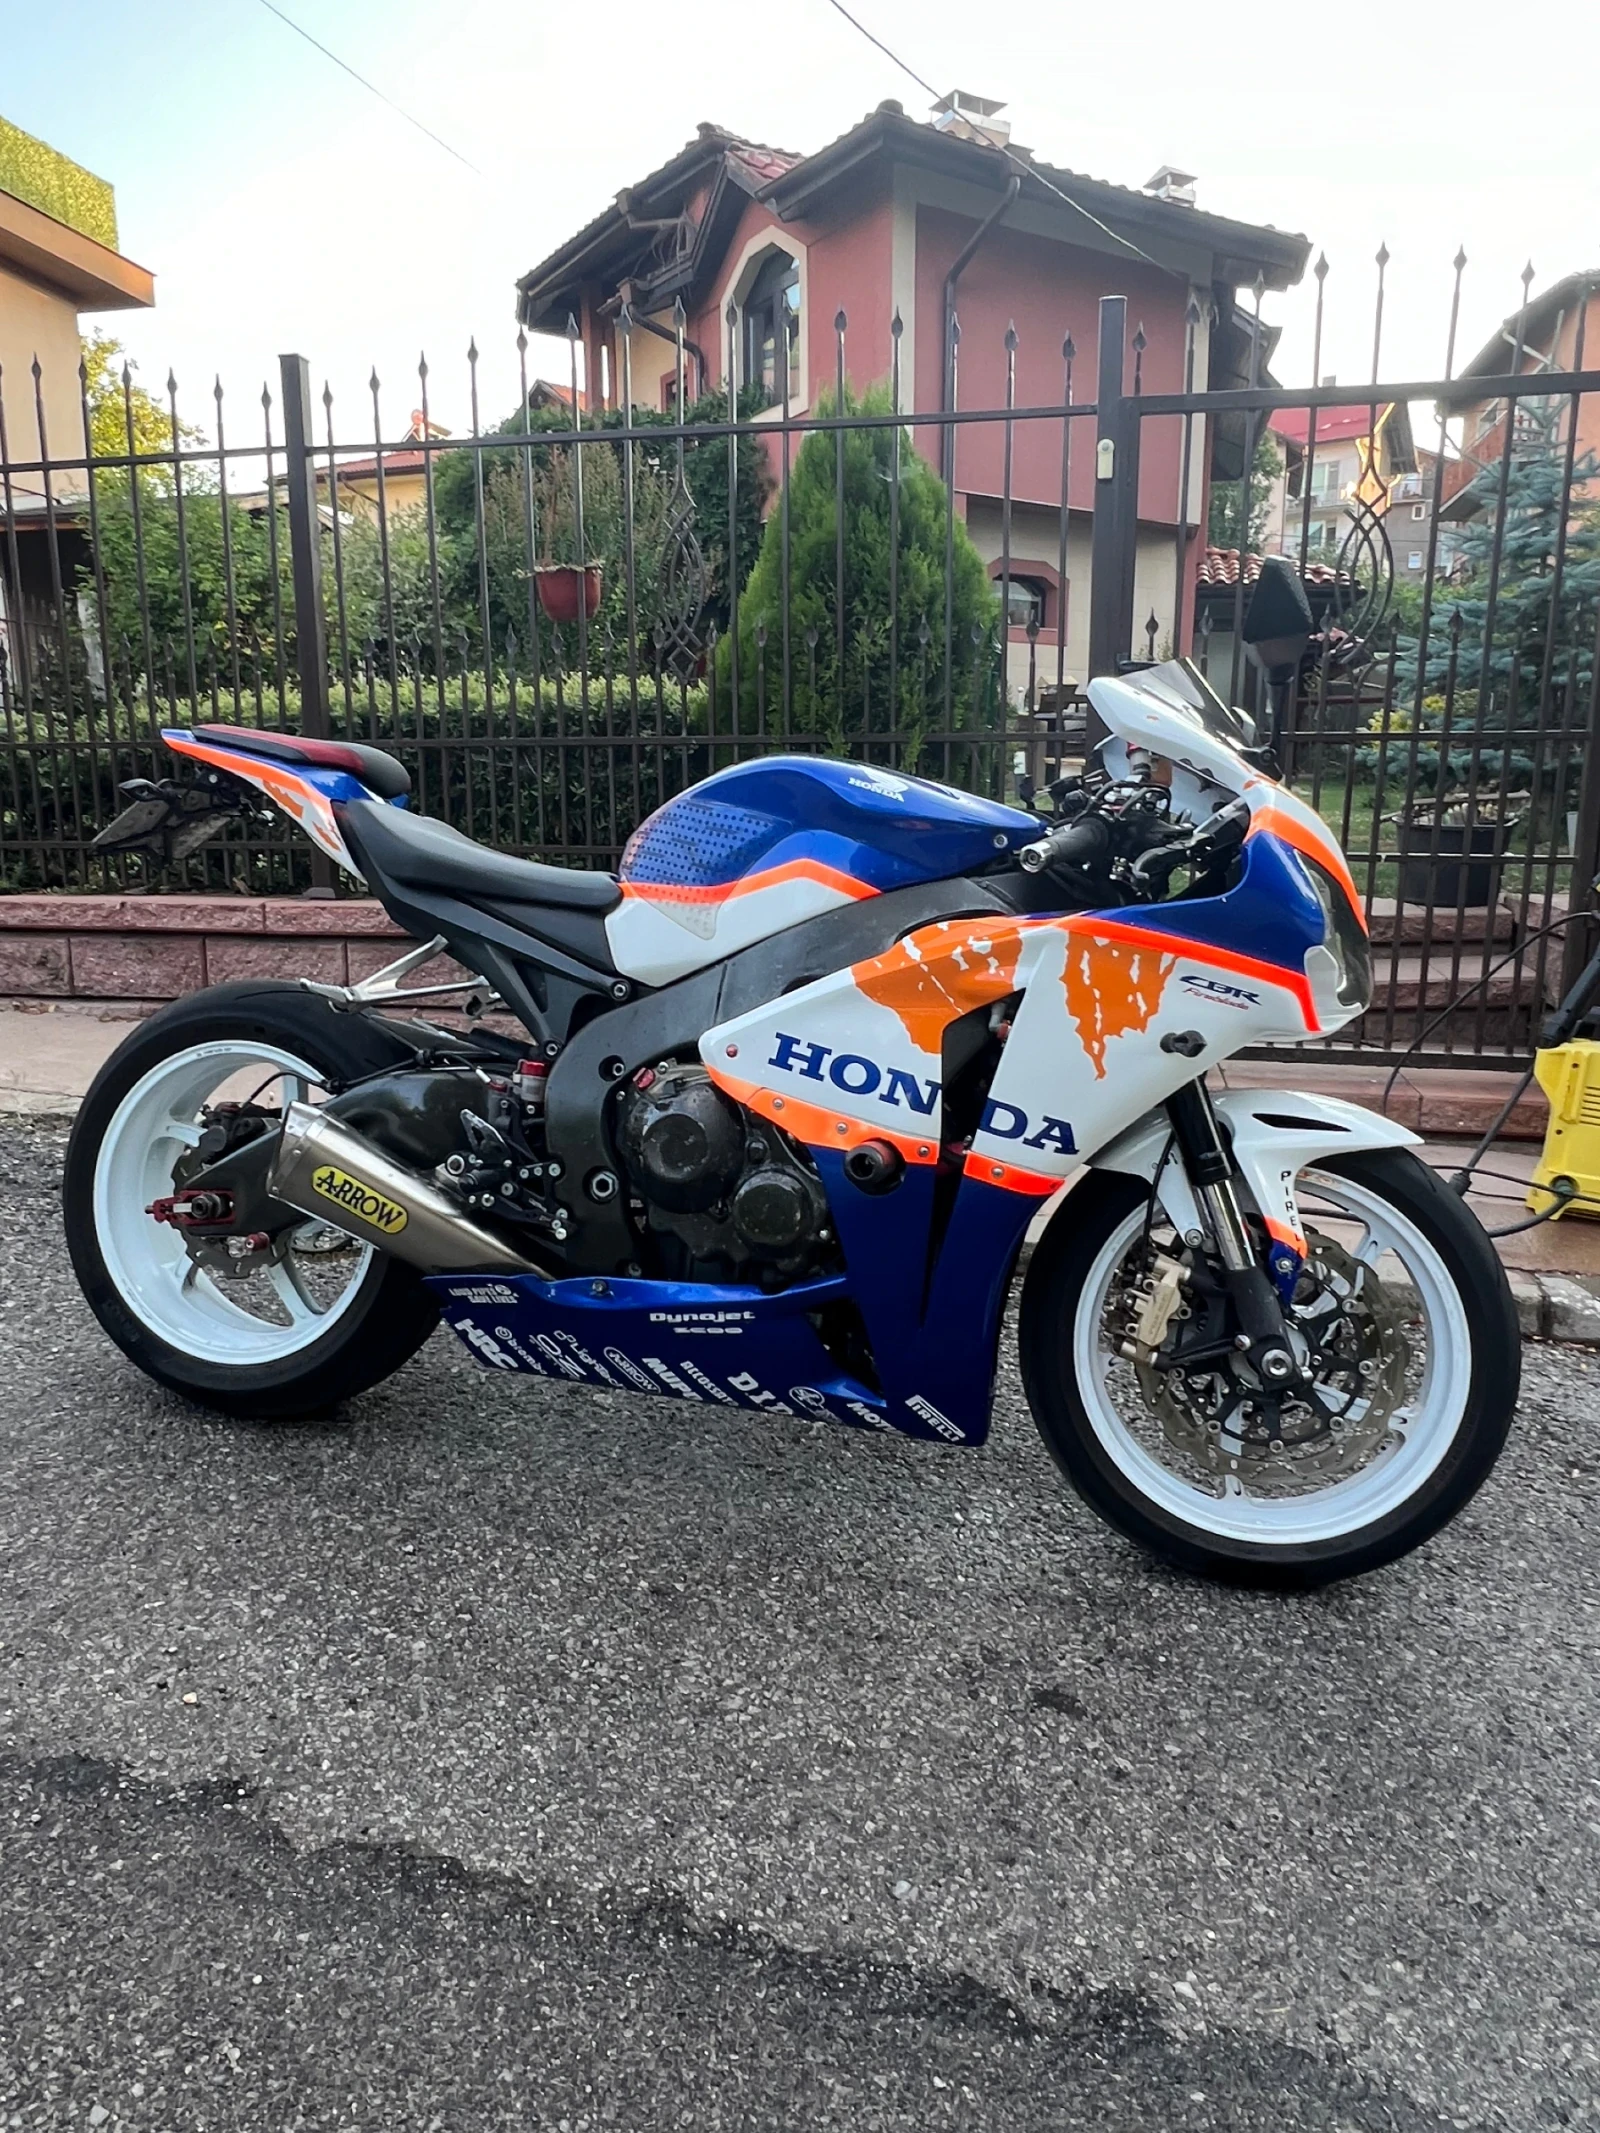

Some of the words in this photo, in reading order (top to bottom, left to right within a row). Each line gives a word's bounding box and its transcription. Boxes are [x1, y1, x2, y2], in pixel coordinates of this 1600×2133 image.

[847, 777, 905, 803] HONDA
[1179, 975, 1263, 1006] CBR
[768, 1032, 1080, 1156] HONDA
[316, 1170, 404, 1227] ARROW
[649, 1311, 756, 1323] Dynojet
[454, 1318, 519, 1369] HRC
[609, 1352, 659, 1392] ARROW
[905, 1394, 966, 1442] PIRELLI
